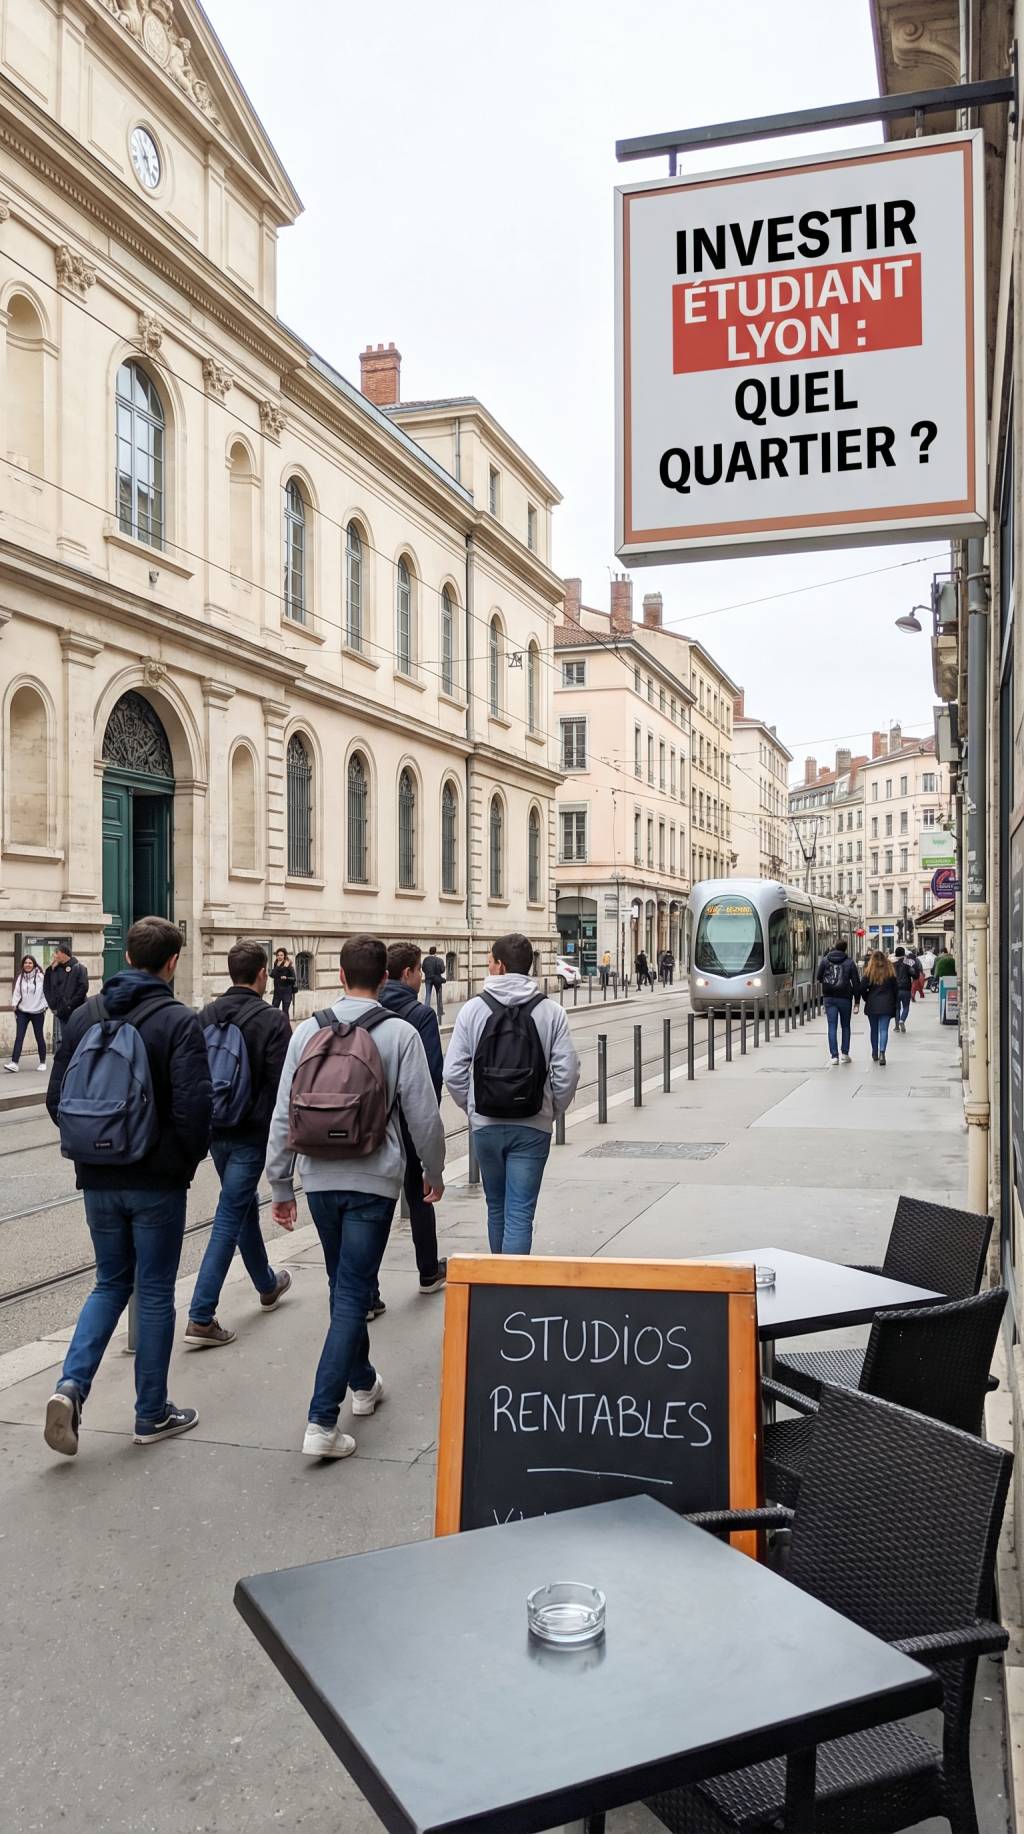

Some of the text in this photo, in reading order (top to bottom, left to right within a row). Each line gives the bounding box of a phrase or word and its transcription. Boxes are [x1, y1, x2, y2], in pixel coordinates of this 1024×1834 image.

[676, 199, 917, 275] INVESTIR
[684, 259, 913, 324] ÉTUDIANT
[727, 313, 840, 362] LYON
[734, 368, 859, 426] QUEL
[659, 420, 938, 494] QUARTIER ?
[489, 1385, 712, 1447] RENTABLES
